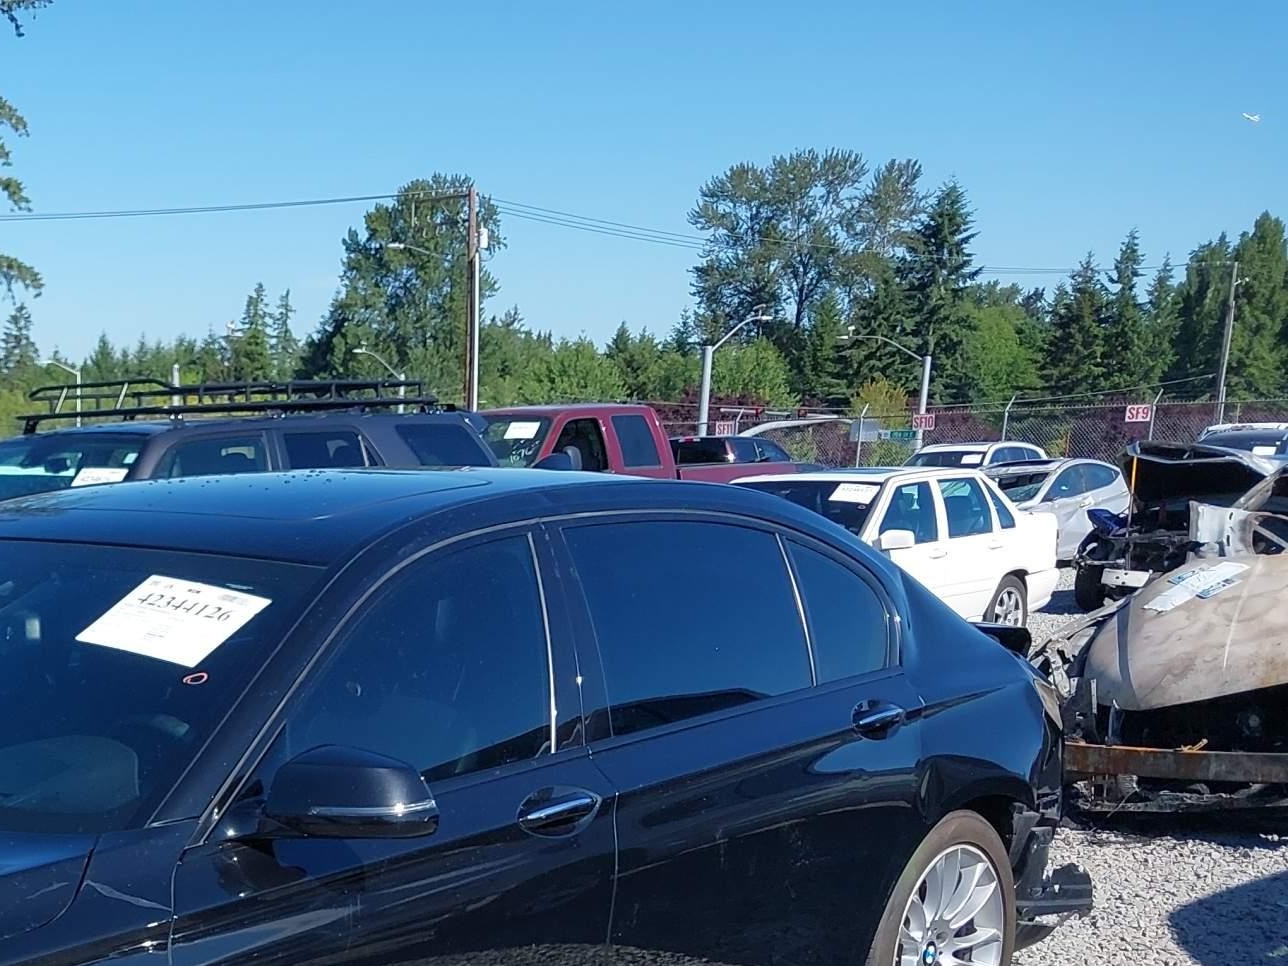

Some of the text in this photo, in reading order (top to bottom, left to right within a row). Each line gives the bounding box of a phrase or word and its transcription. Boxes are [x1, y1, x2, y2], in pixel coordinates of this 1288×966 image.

[1127, 406, 1149, 420] SF9
[717, 423, 733, 435] SF11
[913, 415, 934, 429] SF10
[137, 592, 234, 621] 42344126
